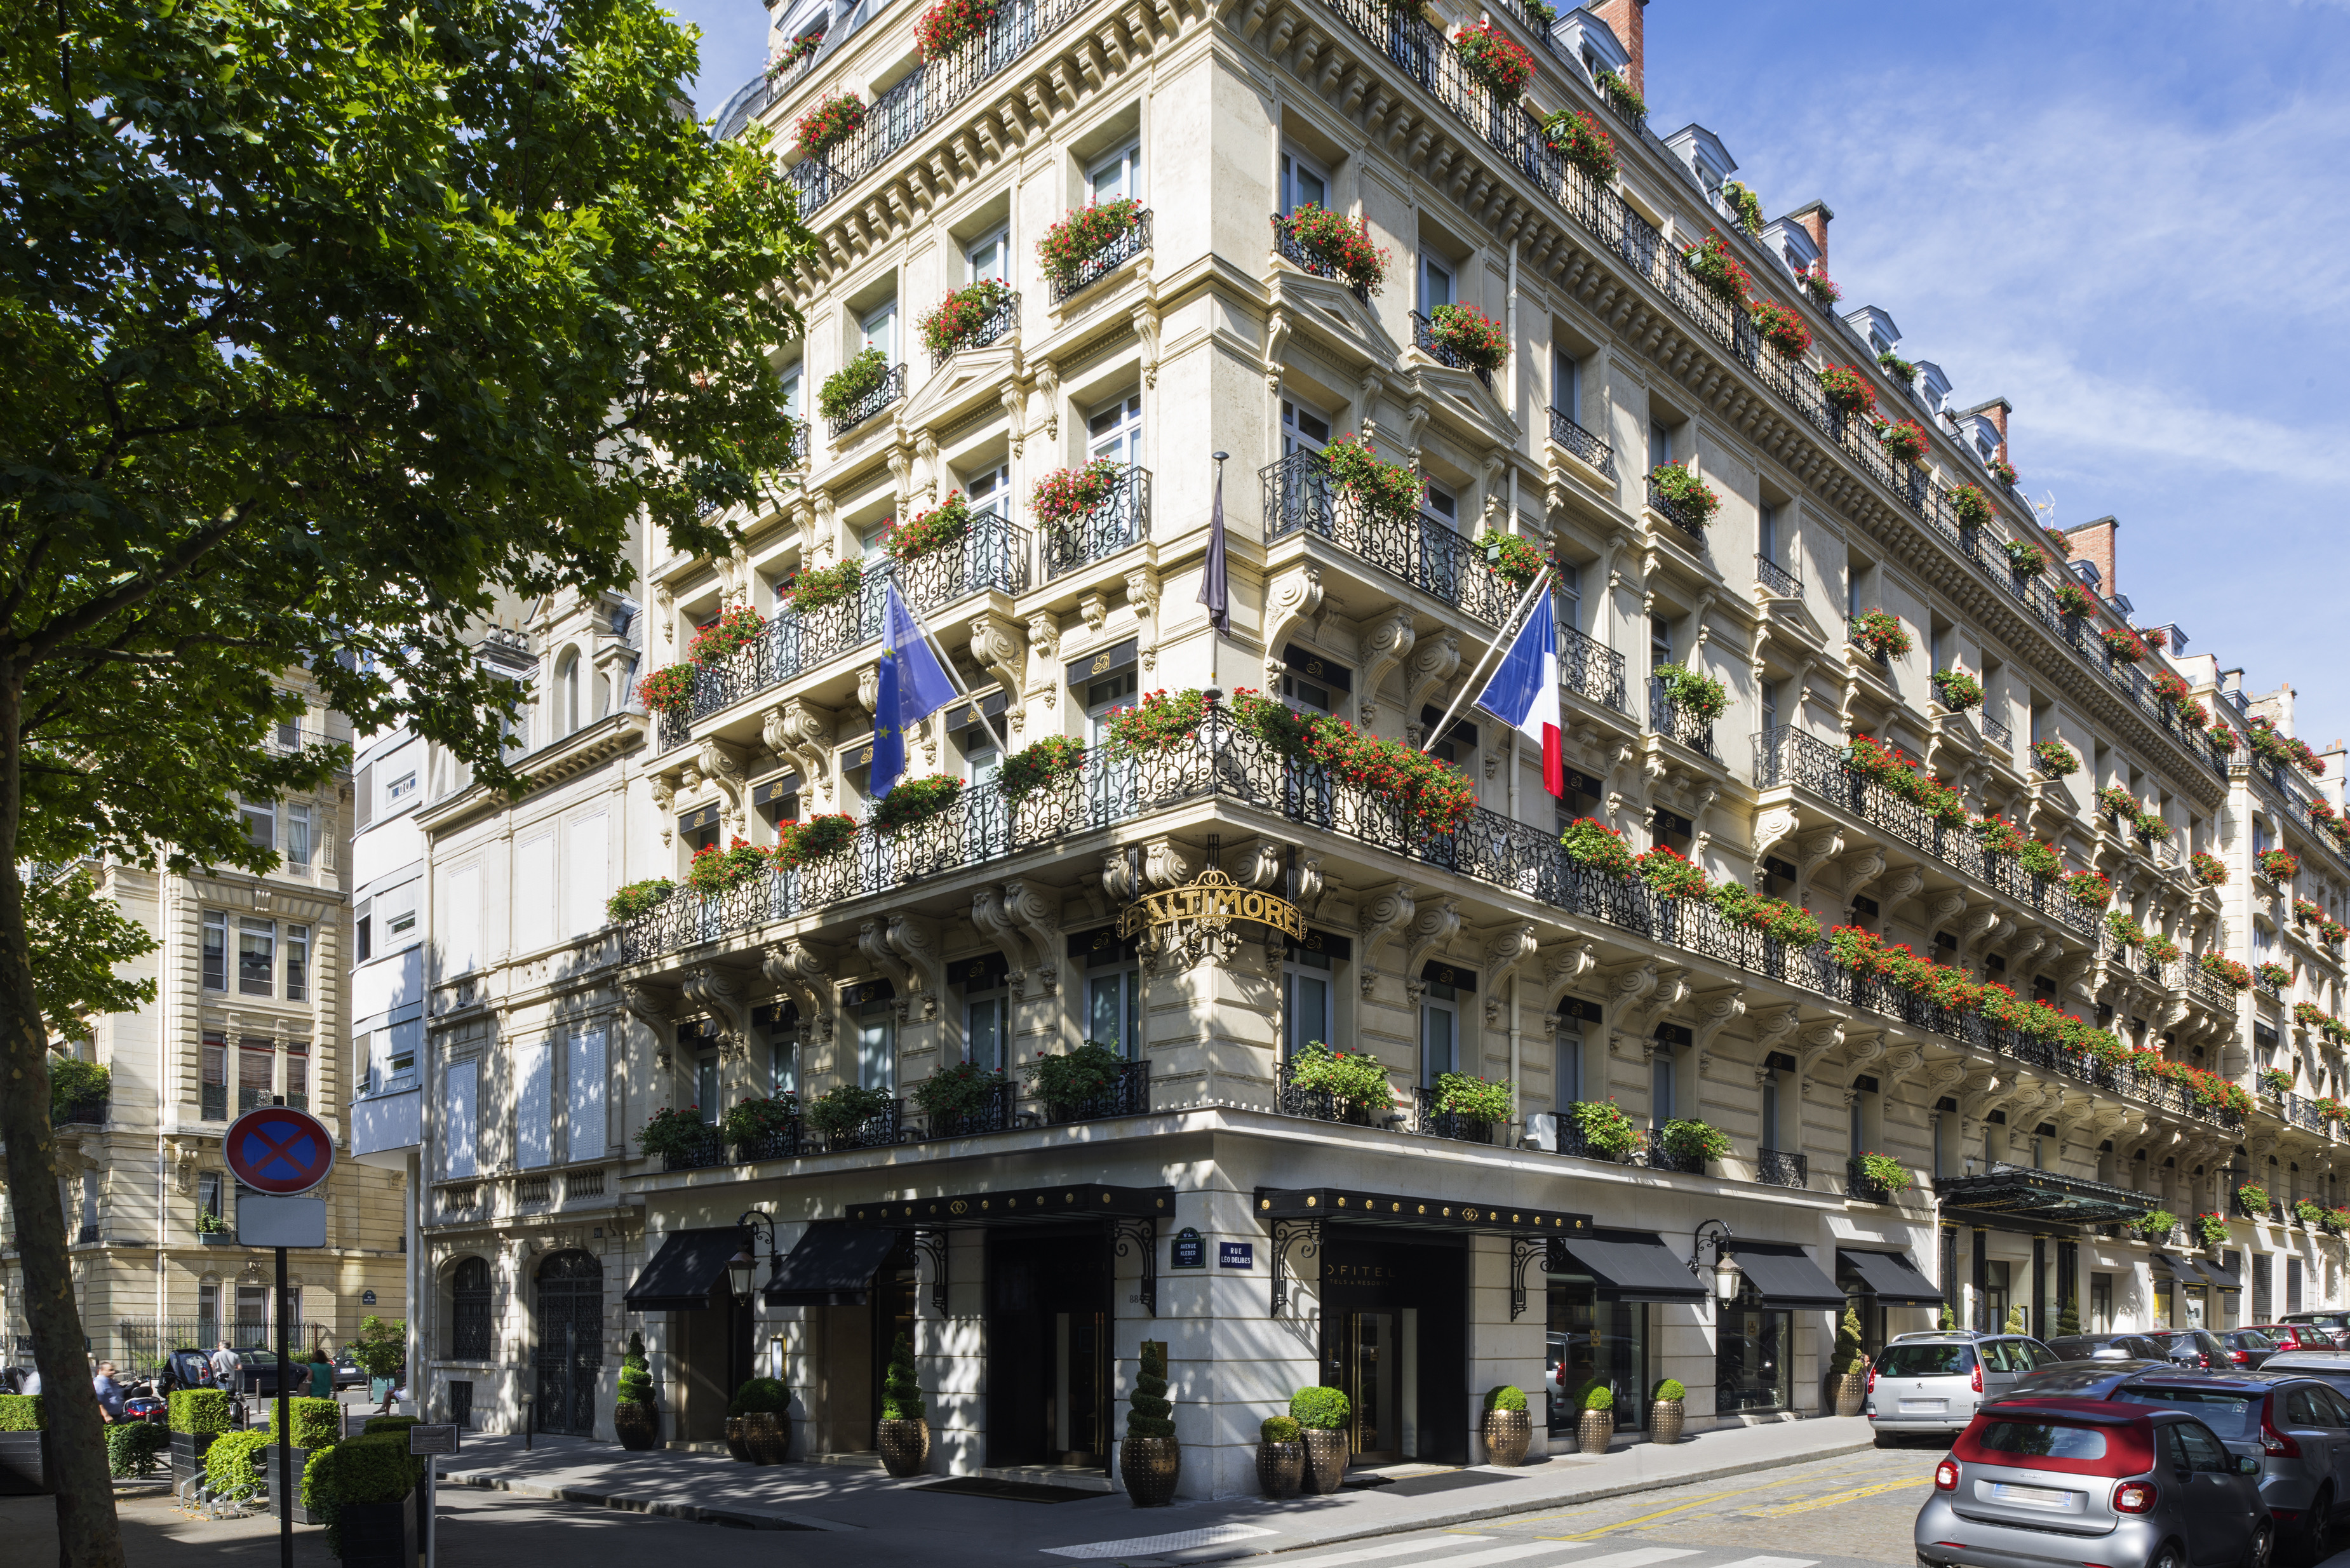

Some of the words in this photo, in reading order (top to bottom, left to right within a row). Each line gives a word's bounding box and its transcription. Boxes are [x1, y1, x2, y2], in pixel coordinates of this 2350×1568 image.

[1125, 890, 1299, 937] BALTIMORE
[594, 1228, 601, 1238] 90
[1231, 1256, 1251, 1264] DELIBES
[1327, 1264, 1396, 1278] OFITEL
[1129, 1294, 1139, 1304] 88
